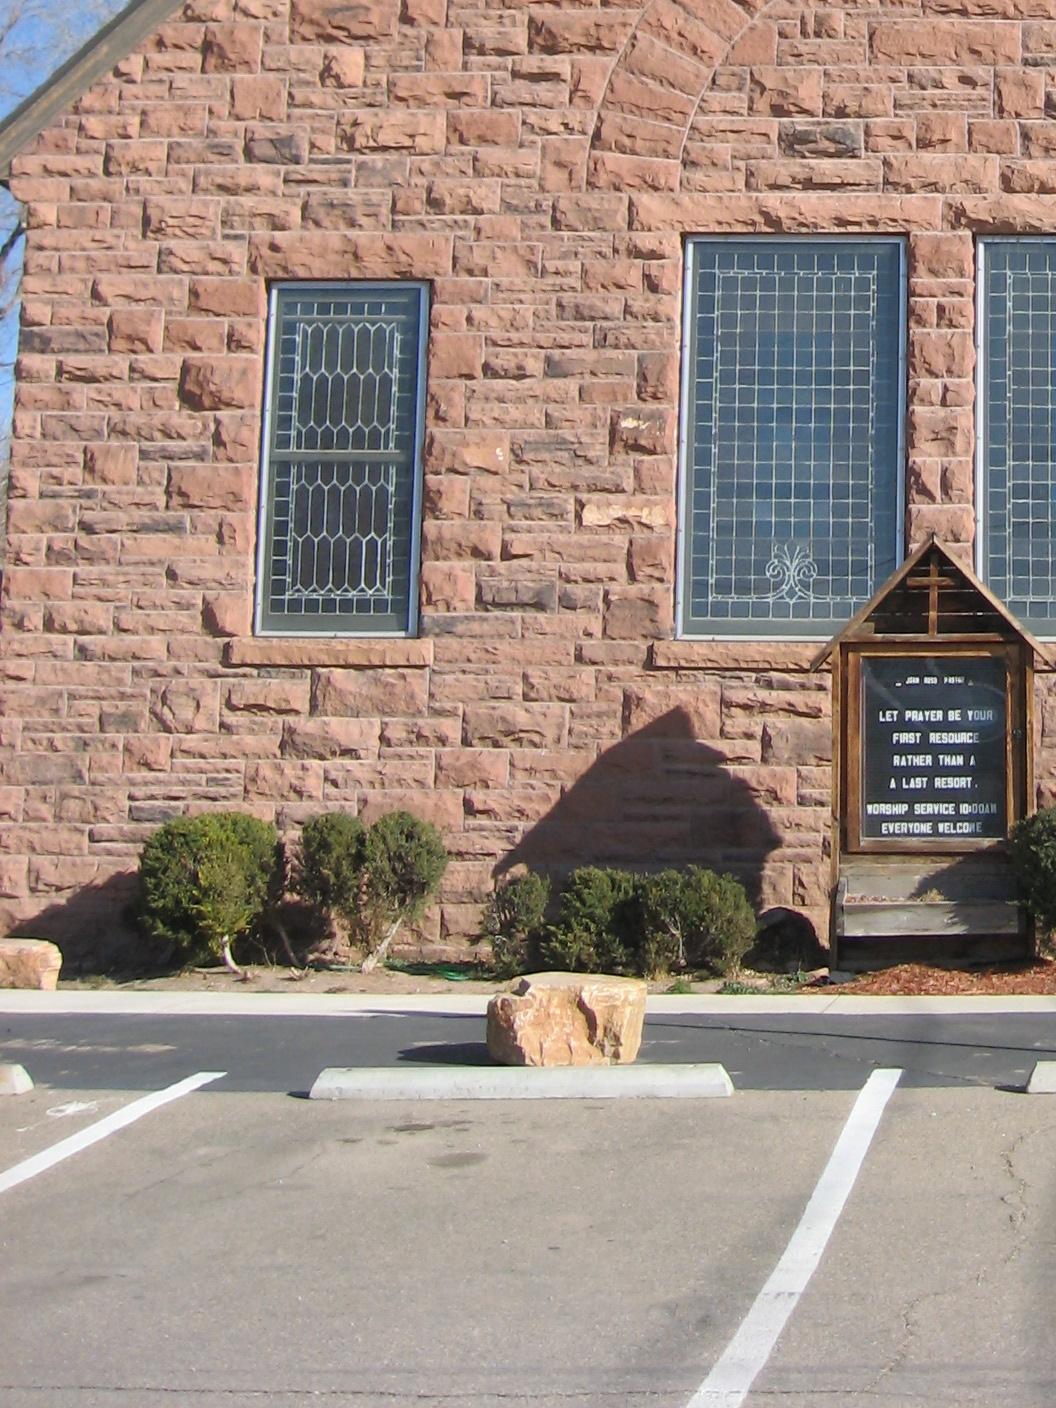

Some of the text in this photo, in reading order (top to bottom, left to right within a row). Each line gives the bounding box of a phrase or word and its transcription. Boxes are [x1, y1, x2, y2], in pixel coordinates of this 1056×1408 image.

[879, 710, 993, 722] LET PRAYER BE YOUR
[892, 732, 979, 744] FIRST RESOURCE
[893, 755, 976, 767] RATHER THAN A
[889, 777, 896, 789] A
[902, 777, 928, 789] LAST
[866, 803, 909, 815] WORSHIP
[914, 803, 955, 815] SERVICE
[881, 822, 982, 834] EVERYONE WELCOME
